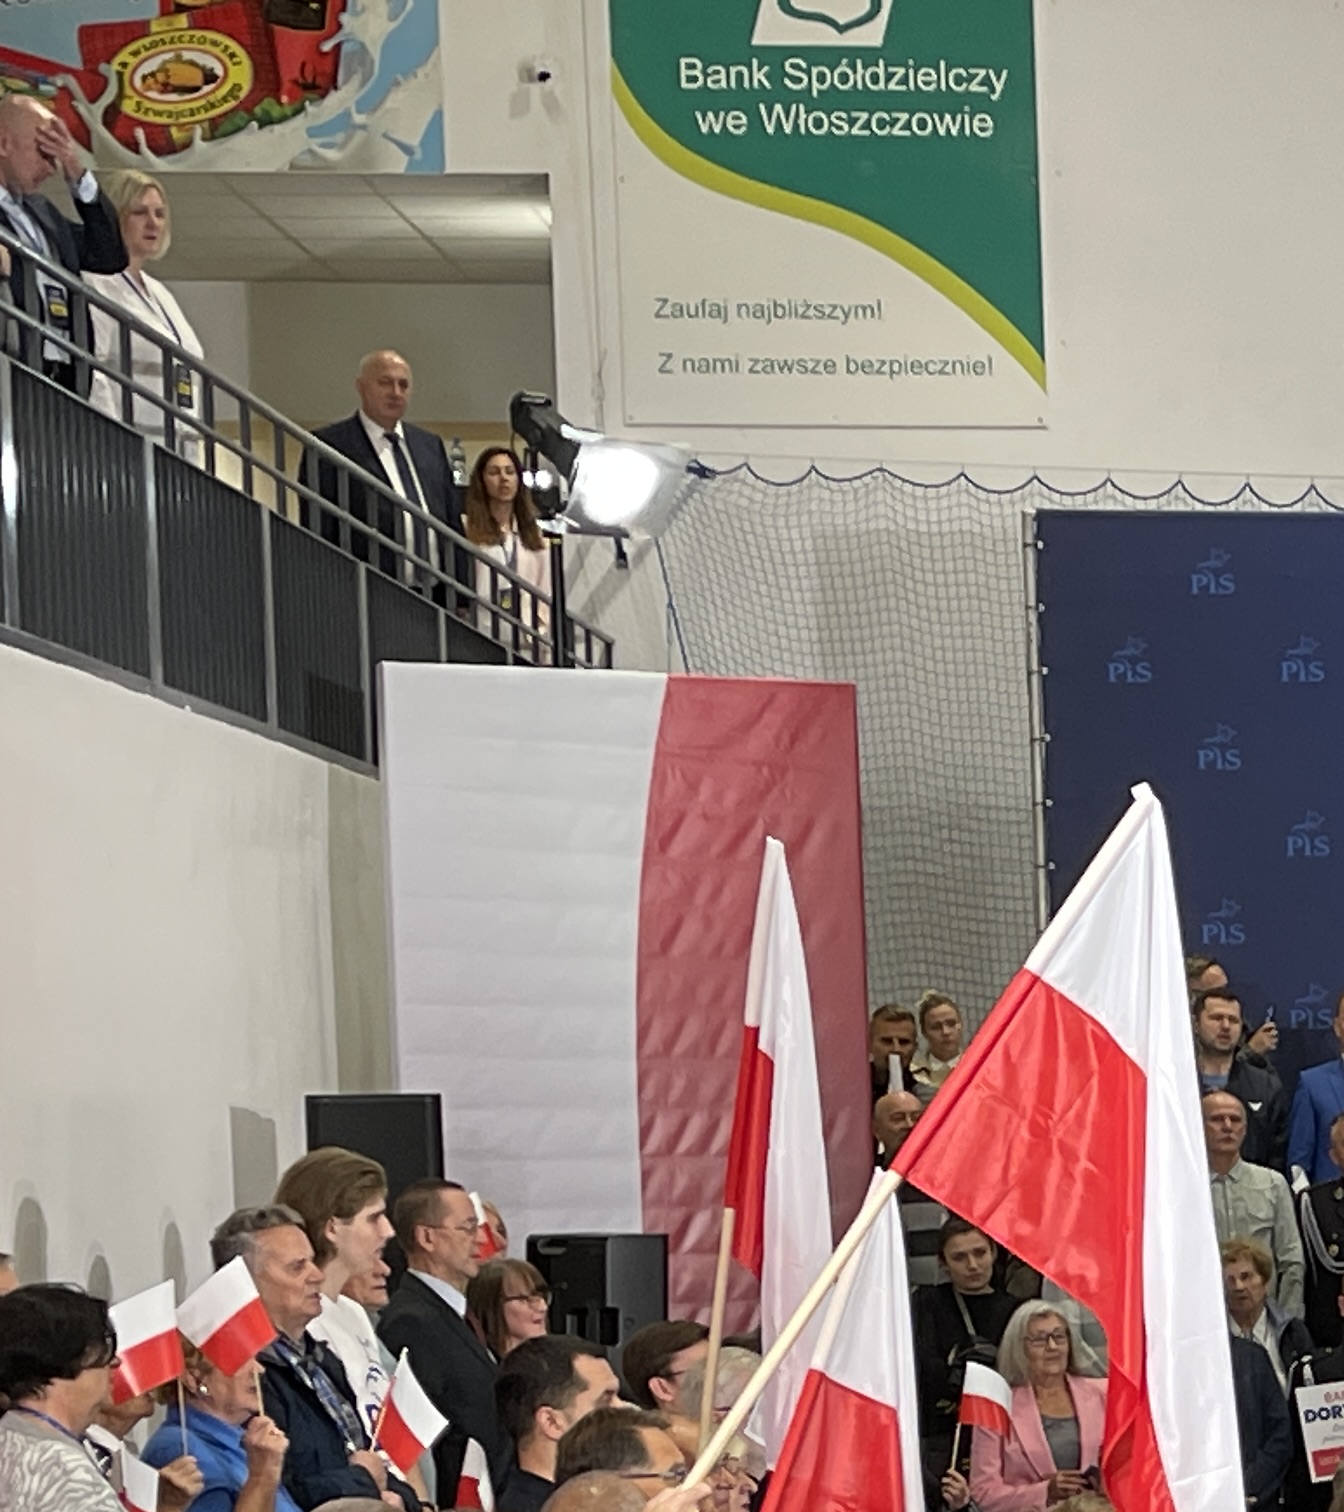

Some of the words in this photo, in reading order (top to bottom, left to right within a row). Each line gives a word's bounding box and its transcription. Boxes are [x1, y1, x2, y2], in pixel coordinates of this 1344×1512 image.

[678, 57, 772, 90] Bank
[783, 57, 1008, 101] Spółdzielczy
[695, 108, 748, 136] we
[758, 102, 995, 138] Włoszczowie
[653, 297, 730, 325] Zaufaj
[736, 298, 883, 326] najbliższym!
[657, 353, 674, 375] Z
[682, 353, 740, 375] nami
[748, 356, 837, 376] zawsze
[845, 353, 994, 381] bezpiecznie!
